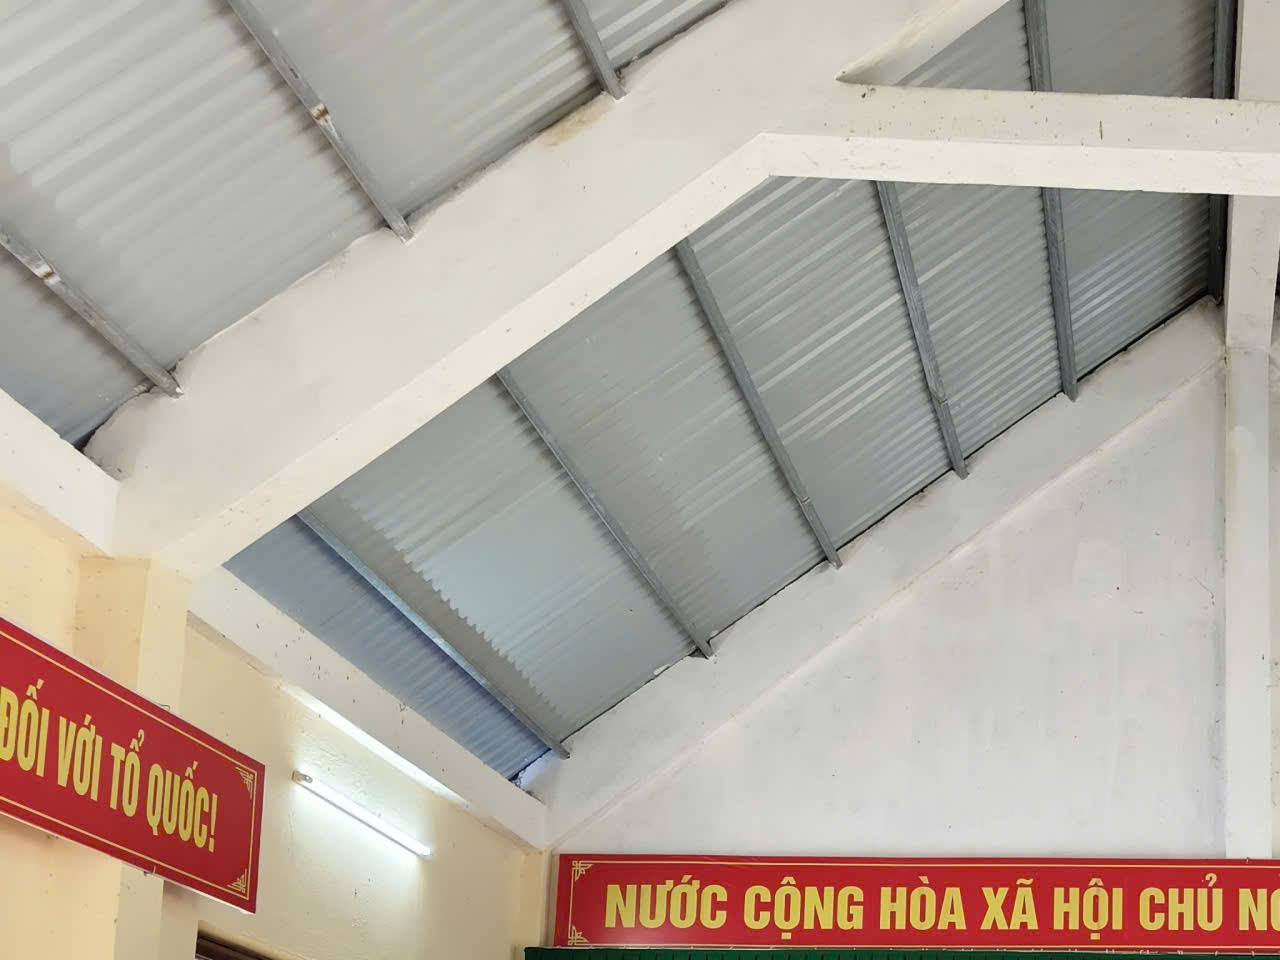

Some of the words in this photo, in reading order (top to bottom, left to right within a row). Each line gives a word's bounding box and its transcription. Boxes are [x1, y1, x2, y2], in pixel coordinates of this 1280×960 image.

[0, 678, 50, 777] ĐỐI
[57, 714, 103, 801] VỚI
[109, 728, 145, 817] TỔ
[146, 760, 218, 853] QUỐC!
[604, 874, 728, 930] NƯỚC
[743, 876, 865, 940] CỘNG
[879, 875, 968, 931] HÒA
[980, 879, 1039, 931] XÃ
[1053, 876, 1123, 940] HỘI
[1139, 873, 1223, 931] CHỦ
